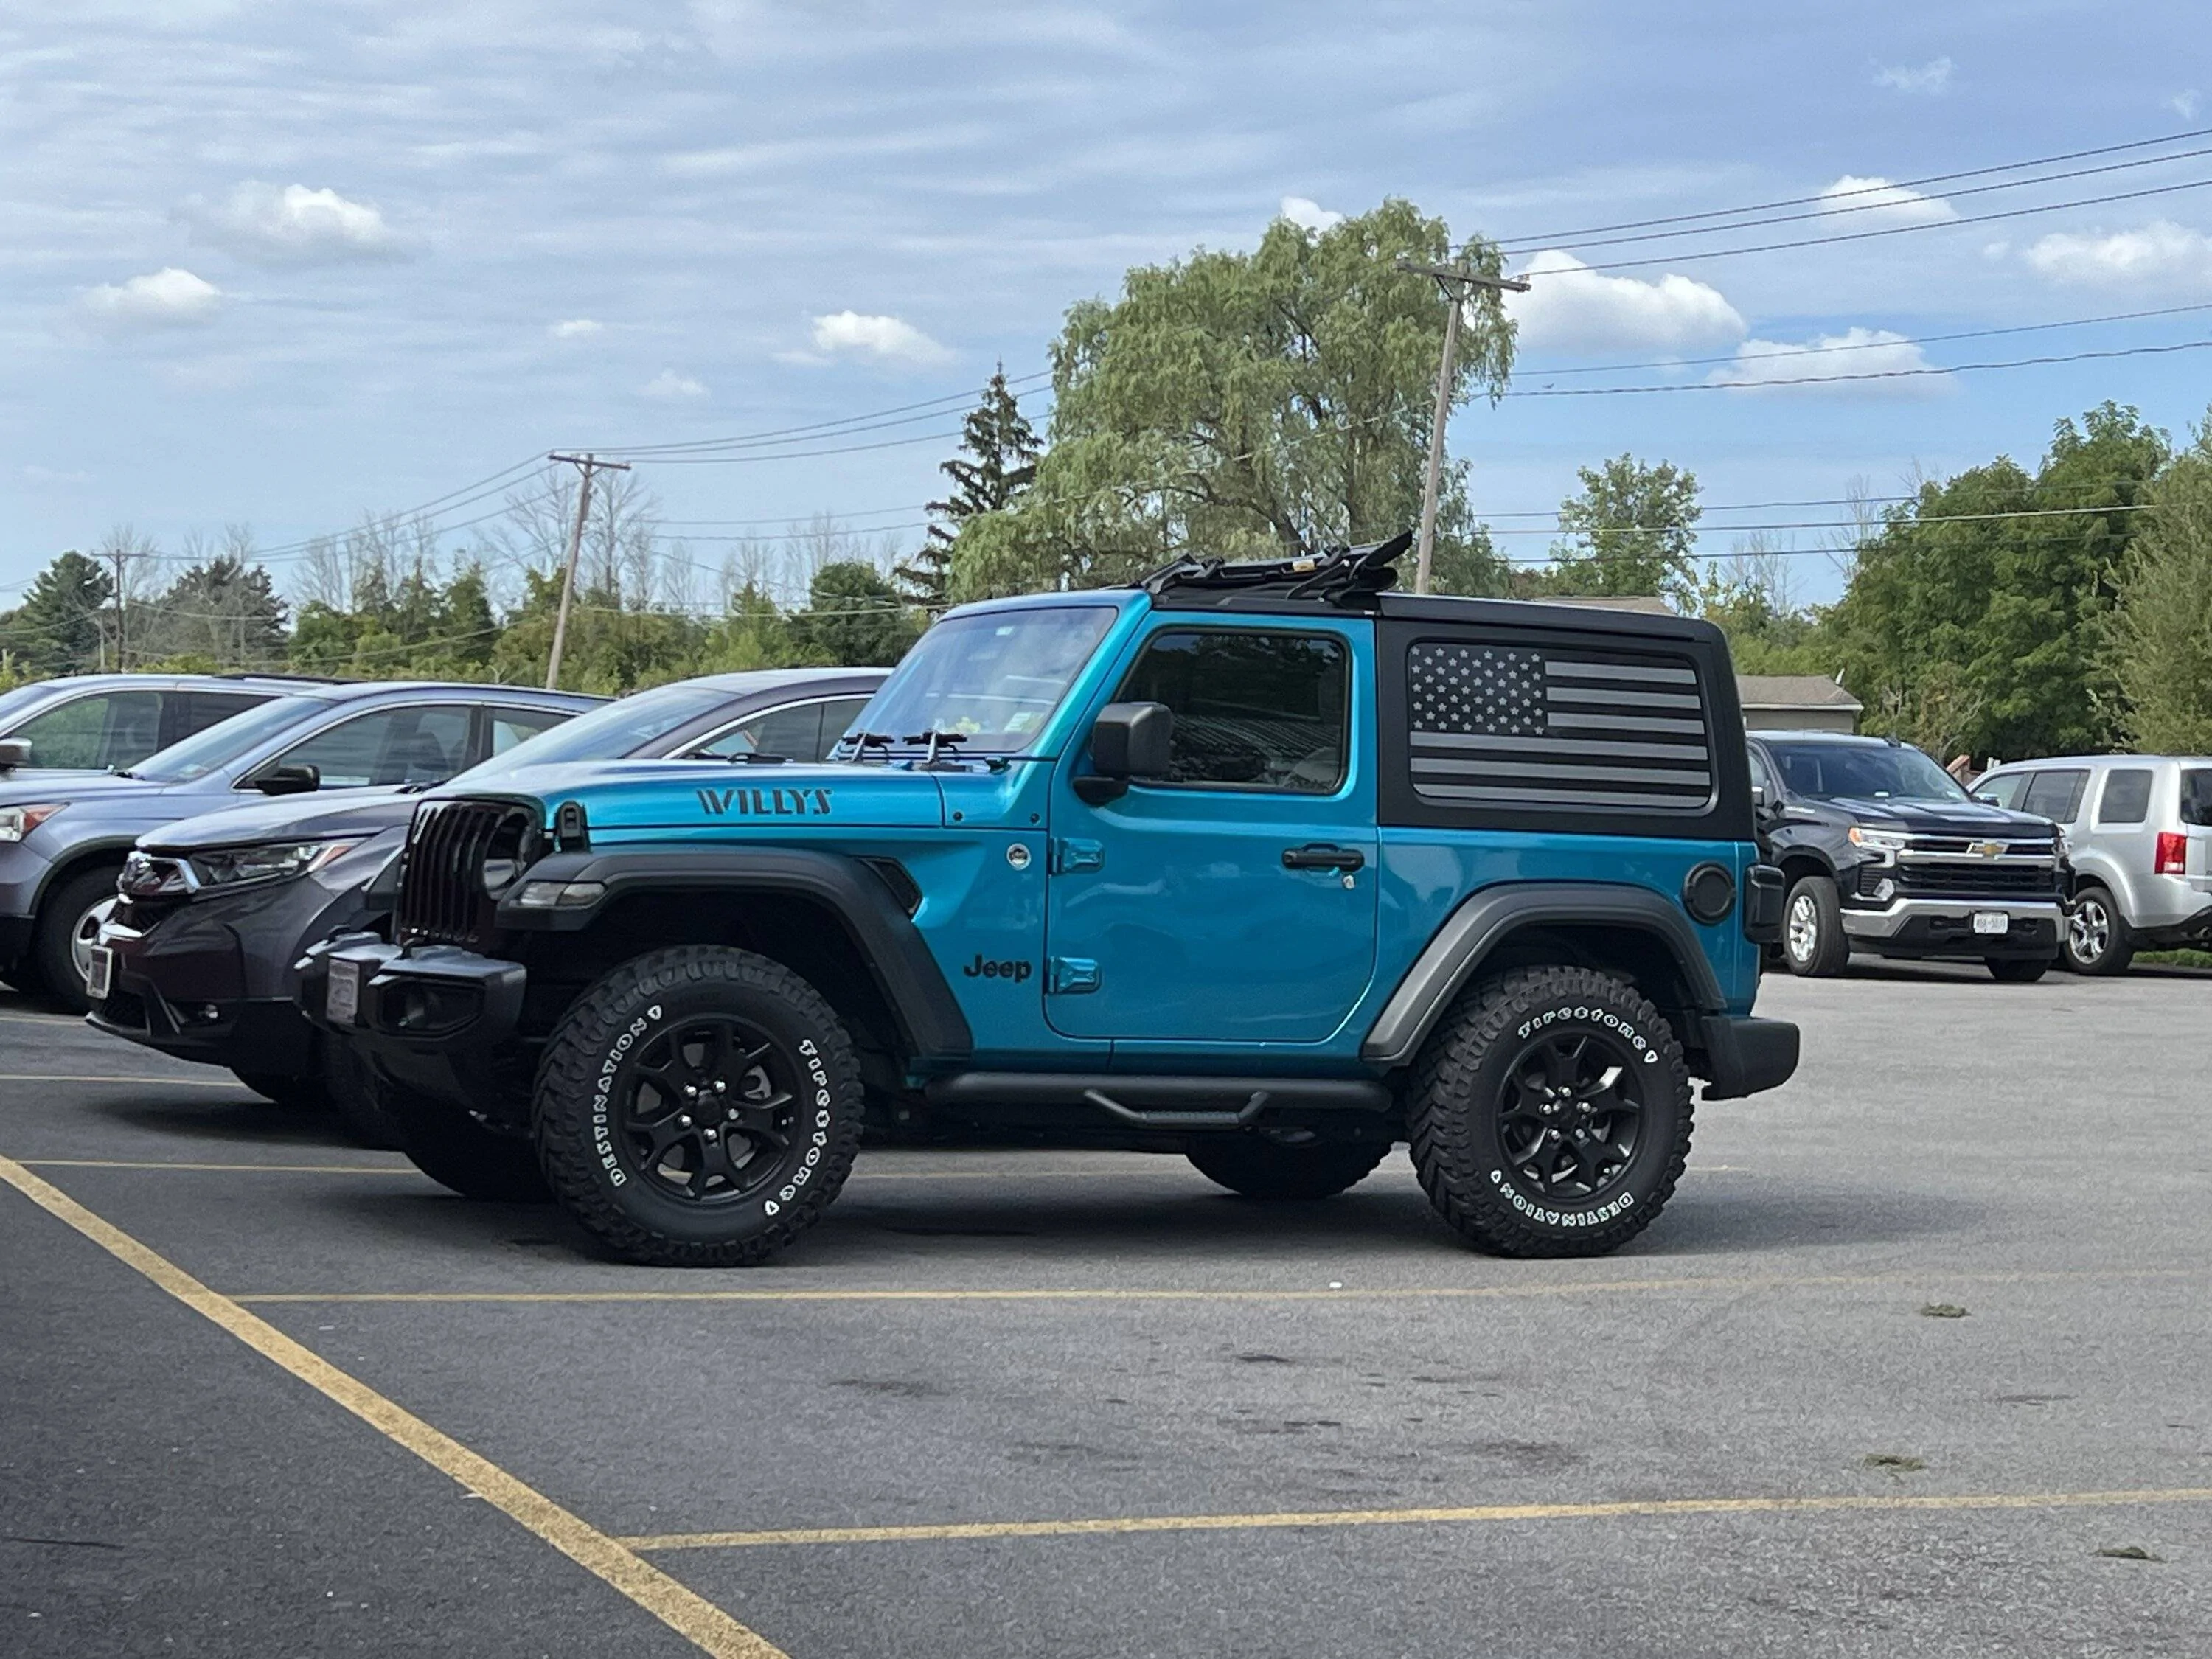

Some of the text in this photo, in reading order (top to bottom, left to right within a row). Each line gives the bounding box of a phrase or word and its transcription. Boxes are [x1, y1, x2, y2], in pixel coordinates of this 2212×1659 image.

[696, 789, 832, 815] WILLYS
[964, 954, 1032, 983] Jeep
[593, 1018, 647, 1187] DESTINATION
[1500, 1183, 1634, 1227] DESTINATION
